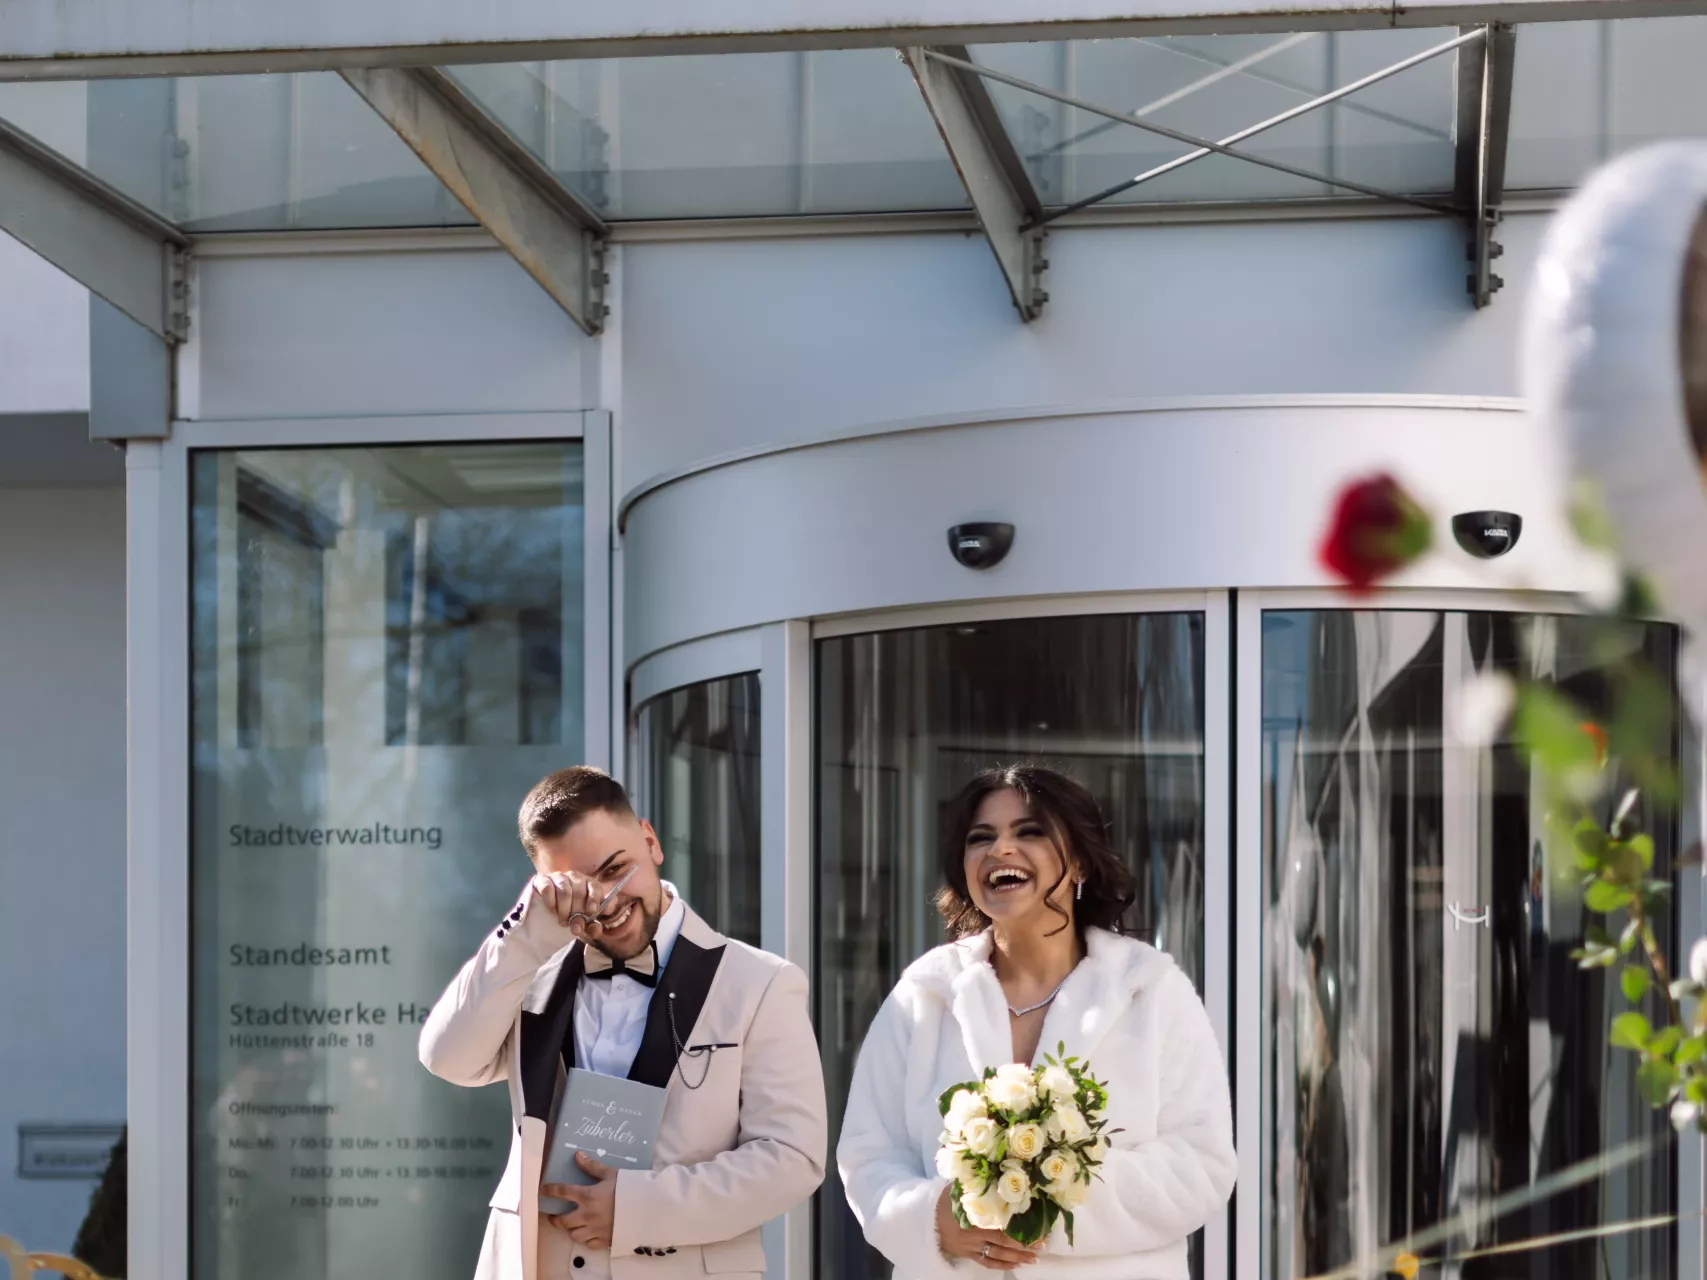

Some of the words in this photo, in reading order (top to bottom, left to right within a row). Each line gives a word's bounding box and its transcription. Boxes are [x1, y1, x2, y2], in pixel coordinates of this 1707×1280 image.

[229, 822, 442, 850] Stadtverwaltung
[229, 942, 392, 966] Standesamt
[229, 1001, 387, 1026] Stadtwerke
[229, 1032, 350, 1049] Hüttenstraße
[356, 1033, 375, 1048] 18
